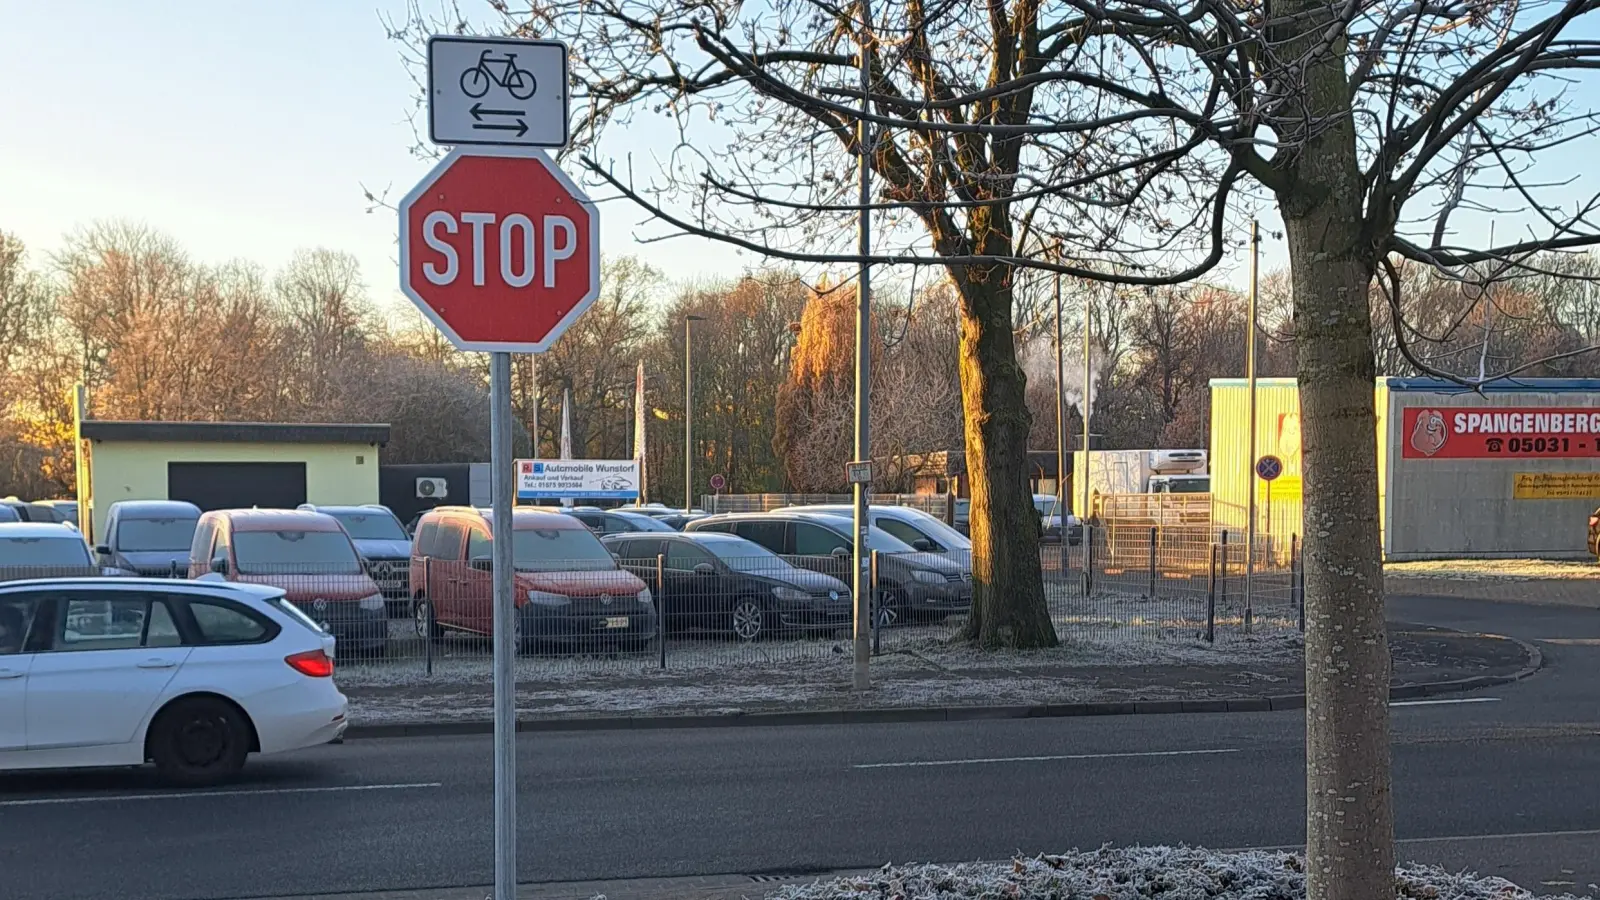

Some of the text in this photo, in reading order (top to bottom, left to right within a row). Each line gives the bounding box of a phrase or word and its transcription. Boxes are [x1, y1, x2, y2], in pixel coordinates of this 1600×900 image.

[422, 210, 577, 288] STOP
[1454, 412, 1600, 434] SPANGENBERG
[1508, 438, 1570, 452] 05031
[545, 464, 594, 473] Automobile
[596, 464, 635, 473] Wunstorf
